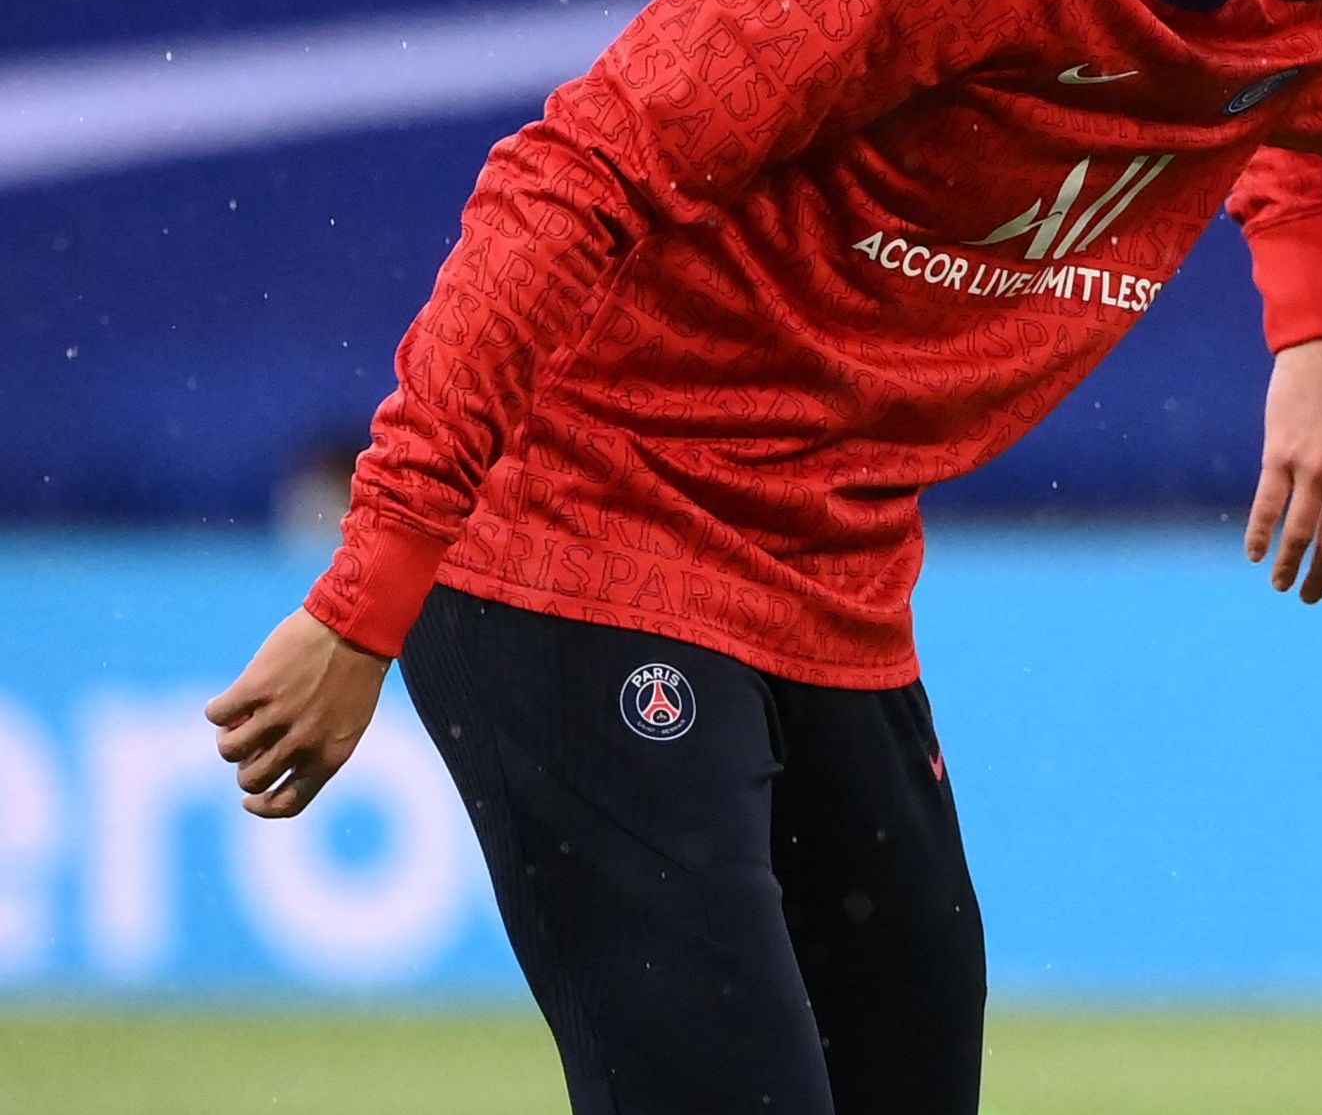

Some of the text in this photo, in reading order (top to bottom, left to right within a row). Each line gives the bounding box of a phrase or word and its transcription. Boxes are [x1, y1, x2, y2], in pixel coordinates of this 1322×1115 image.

[852, 231, 969, 289] ACCOR
[968, 264, 1033, 297] LIVE
[631, 667, 680, 688] PARIS
